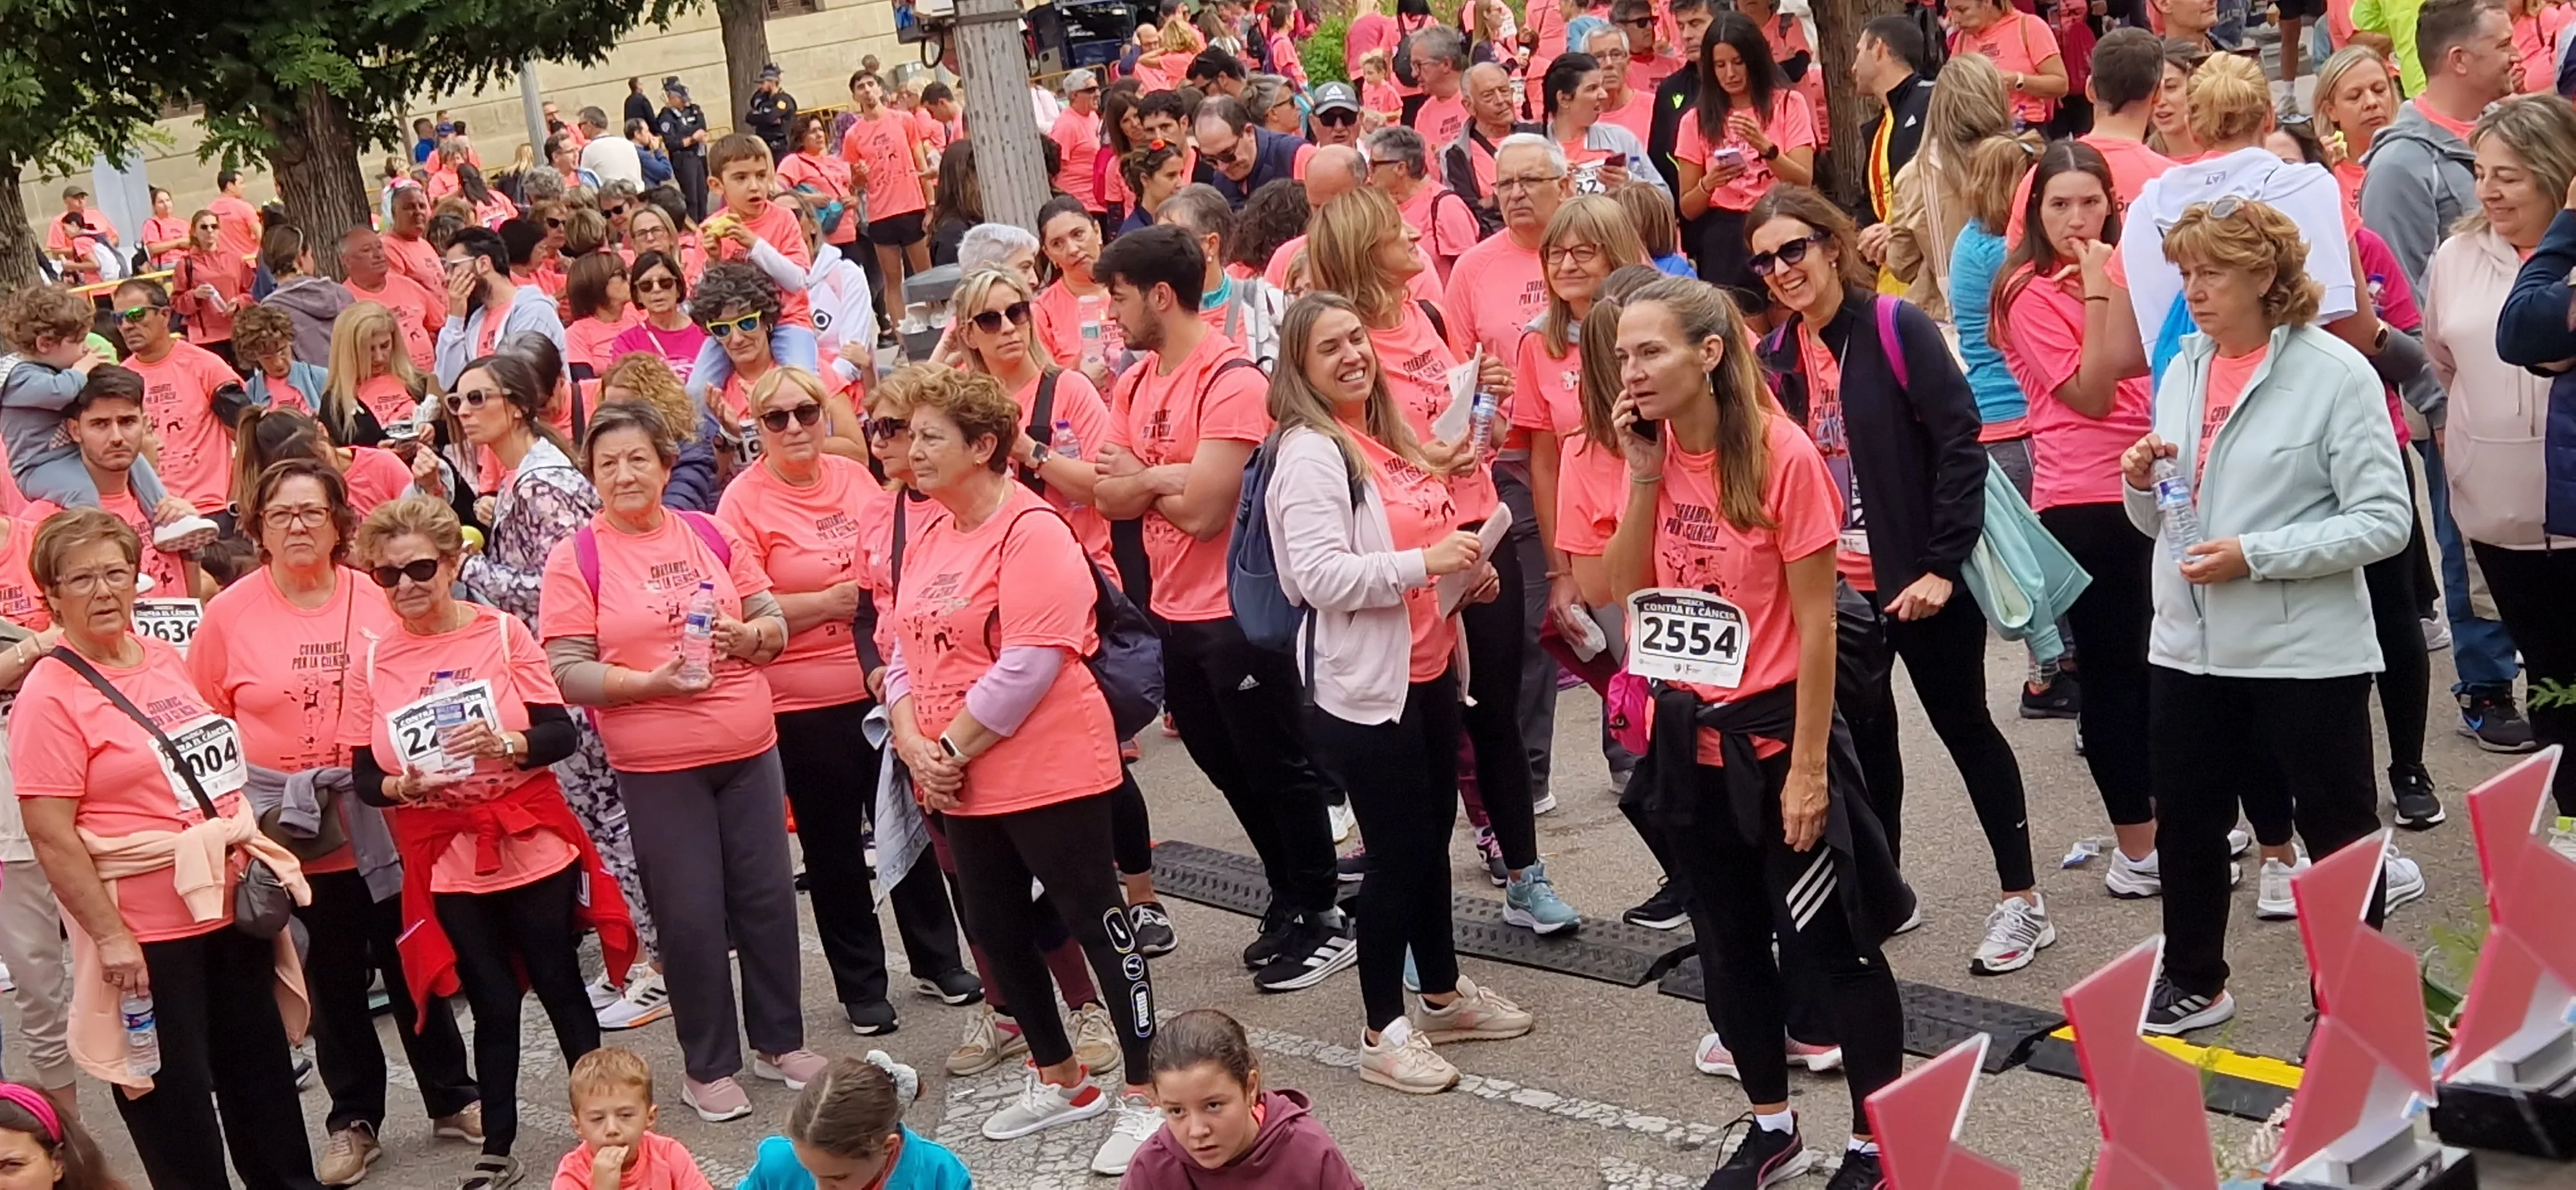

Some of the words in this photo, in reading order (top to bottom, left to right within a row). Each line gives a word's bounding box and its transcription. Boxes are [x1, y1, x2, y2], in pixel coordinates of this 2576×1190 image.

[1643, 602, 1683, 614] CONTRA
[1685, 606, 1697, 616] EL
[1698, 607, 1738, 621] CÁNCER
[1642, 616, 1738, 660] 2554
